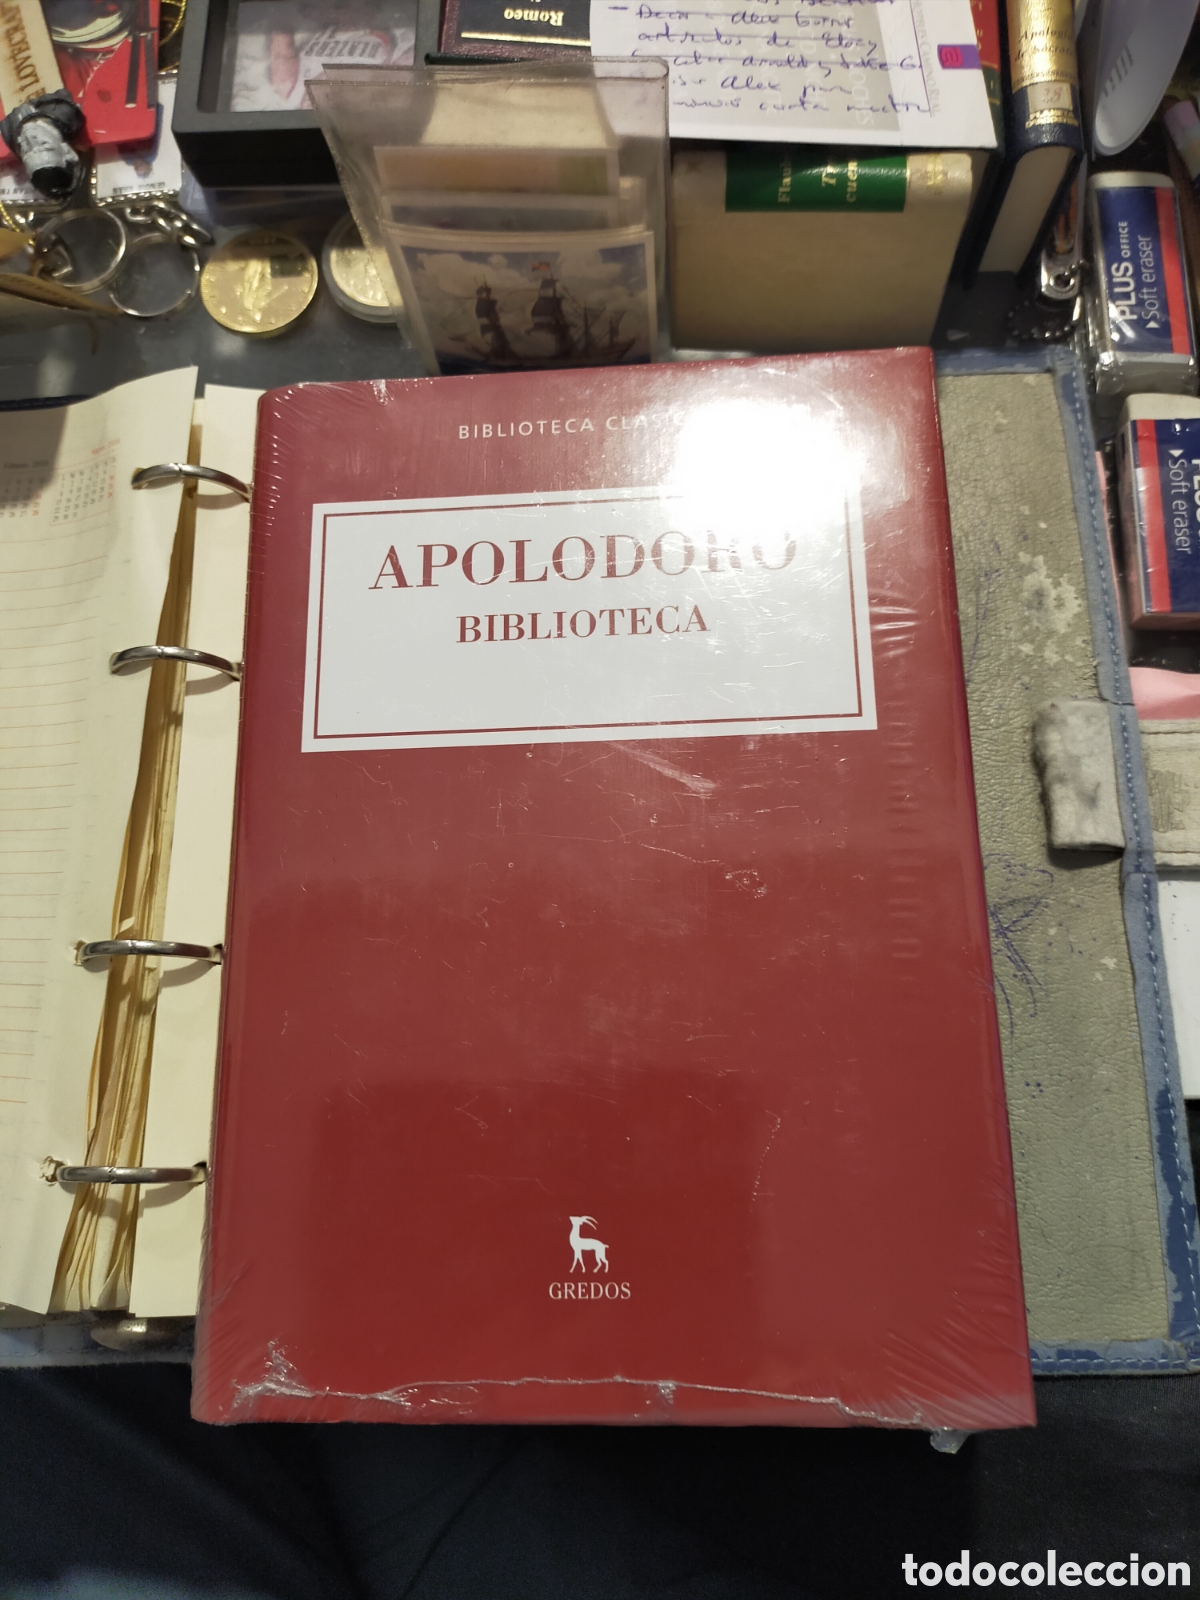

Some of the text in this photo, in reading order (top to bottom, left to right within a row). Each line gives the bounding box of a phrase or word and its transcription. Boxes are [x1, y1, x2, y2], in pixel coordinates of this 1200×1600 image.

[503, 8, 564, 27] Romeo
[1111, 220, 1138, 321] PLUS OFFICE
[1137, 234, 1161, 319] Soft eraser
[458, 418, 594, 440] BIBLIOTECA
[1167, 459, 1193, 555] Soft eraser
[368, 528, 798, 590] APOLODORO
[456, 604, 711, 644] BIBLIOTECA
[548, 1281, 631, 1300] GREDOS
